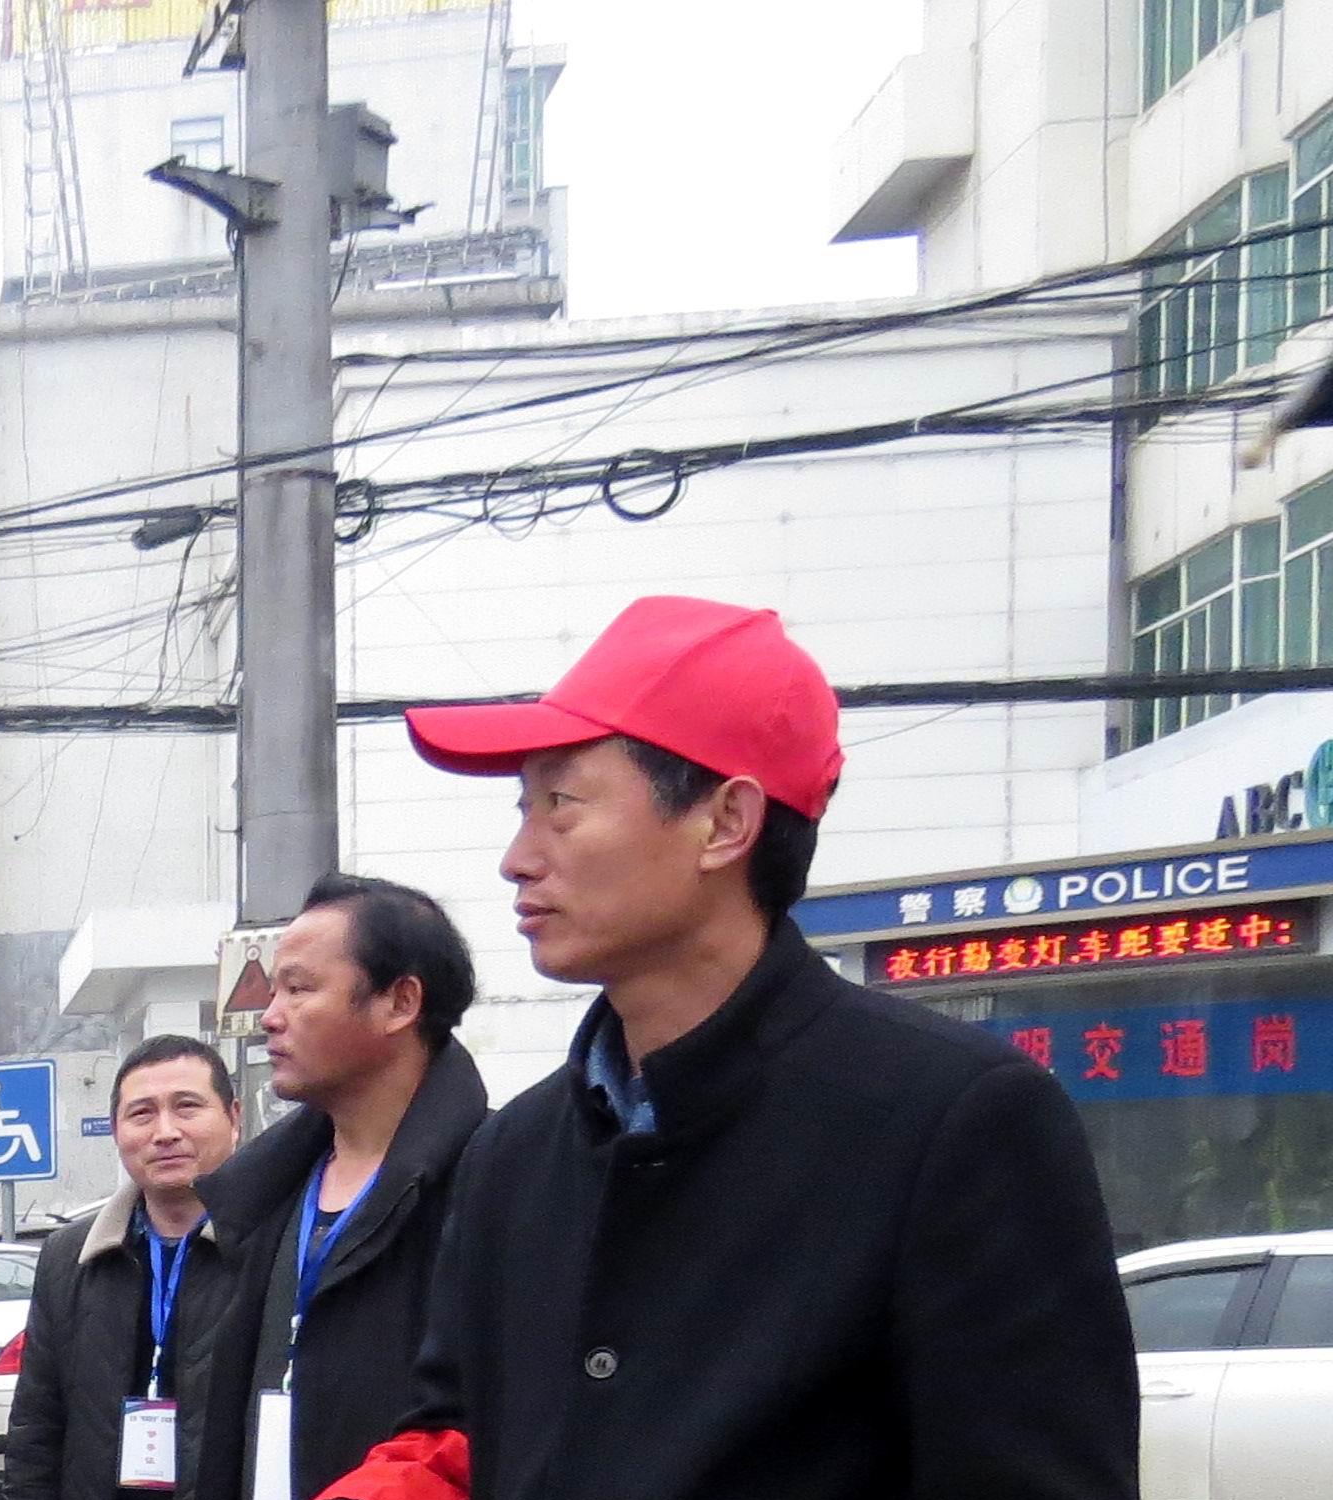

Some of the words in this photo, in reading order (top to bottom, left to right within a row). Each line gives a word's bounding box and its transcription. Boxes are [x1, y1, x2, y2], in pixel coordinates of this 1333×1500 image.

[1216, 770, 1305, 840] ABC
[899, 884, 987, 925] 警察
[1058, 856, 1250, 910] POLICE
